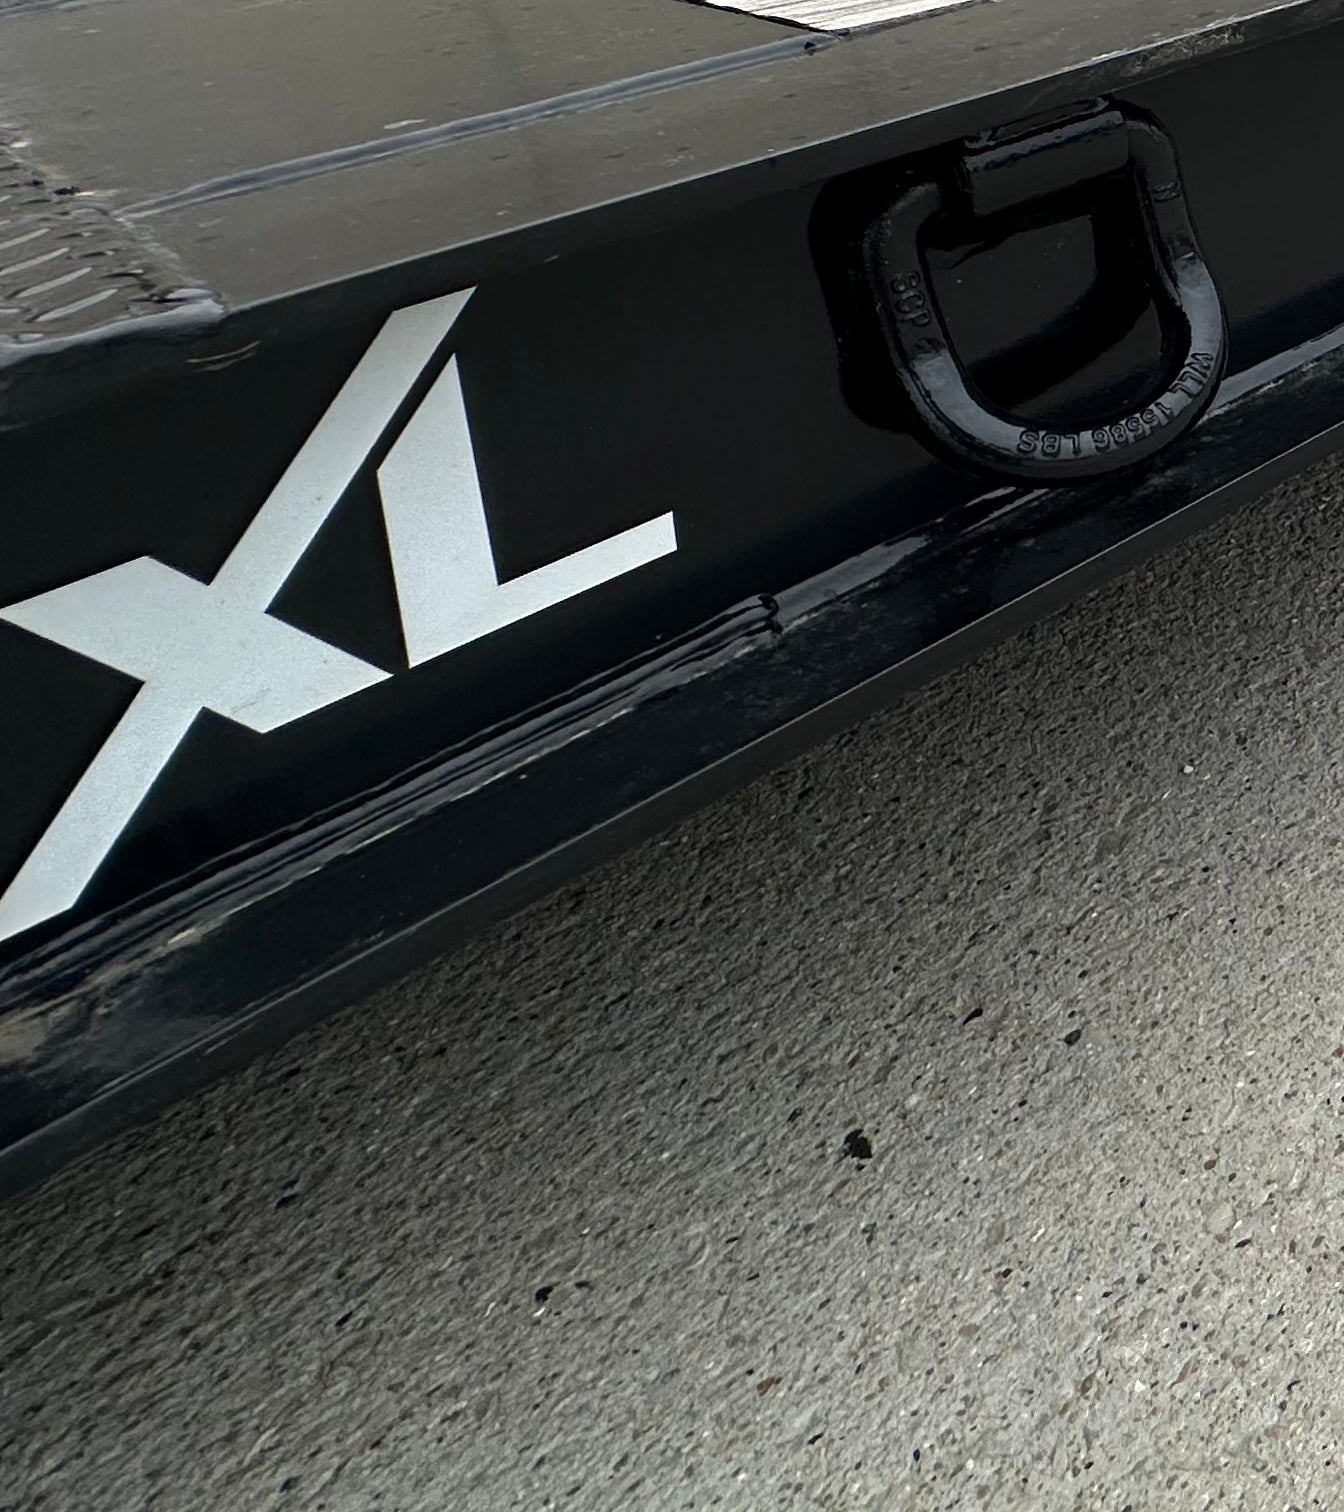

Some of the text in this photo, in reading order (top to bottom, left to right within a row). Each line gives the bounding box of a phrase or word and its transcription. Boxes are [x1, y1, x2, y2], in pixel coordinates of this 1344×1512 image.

[1168, 352, 1214, 398] WLL
[1016, 428, 1082, 458] LBS
[0, 285, 678, 942] XL
